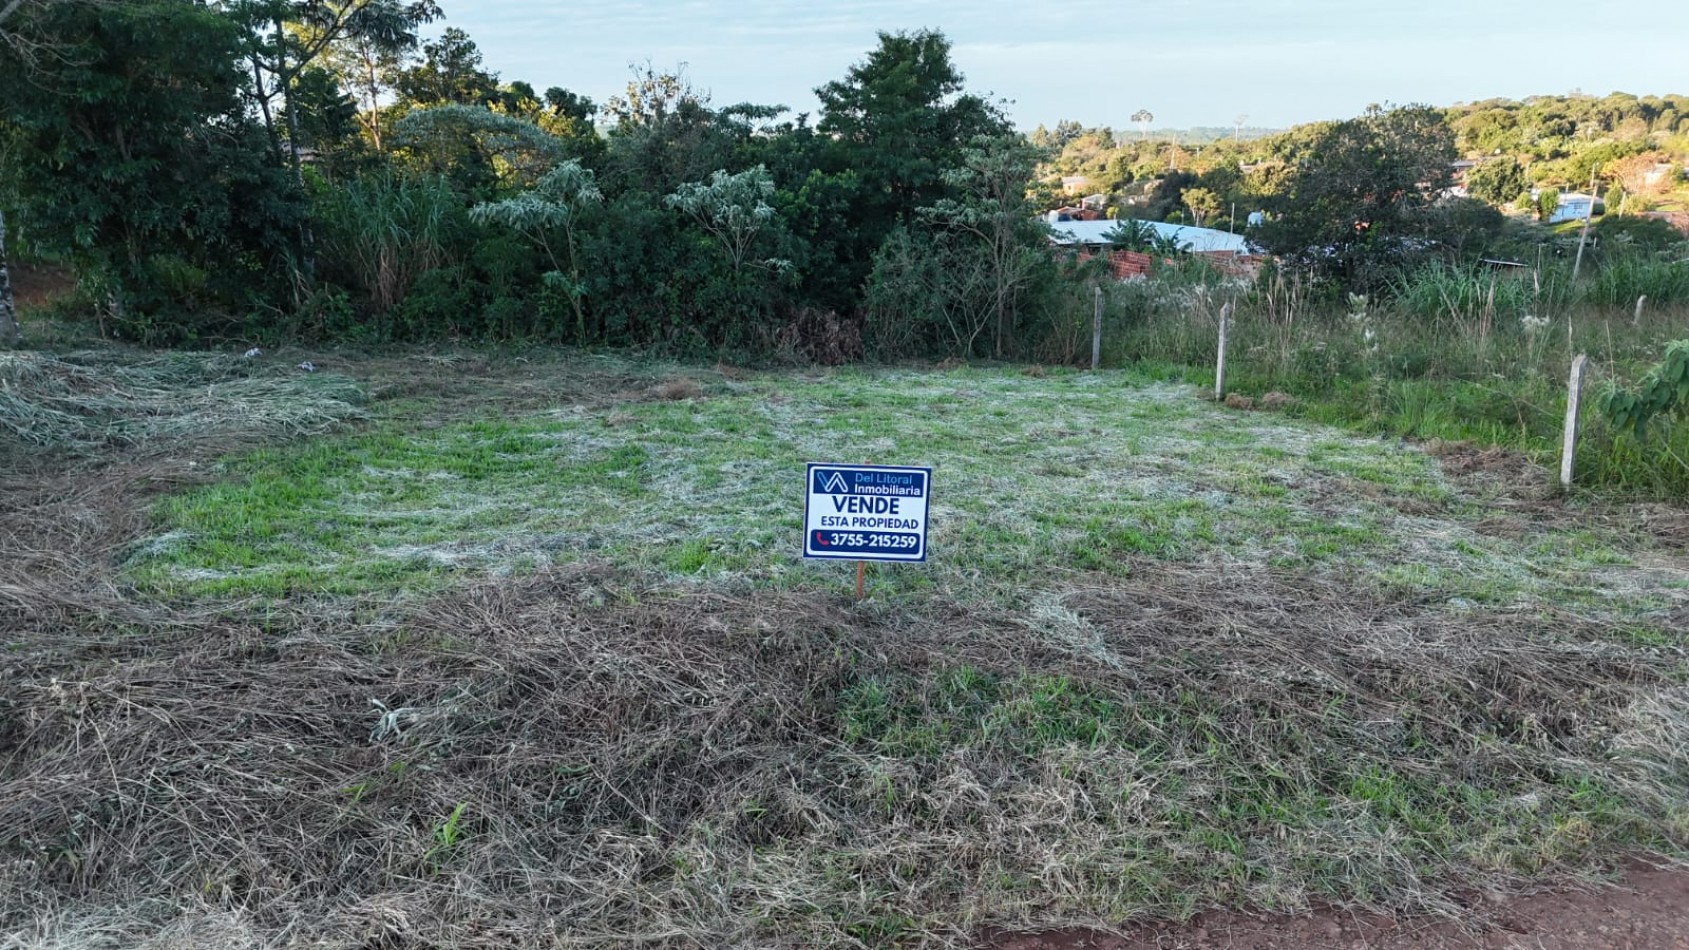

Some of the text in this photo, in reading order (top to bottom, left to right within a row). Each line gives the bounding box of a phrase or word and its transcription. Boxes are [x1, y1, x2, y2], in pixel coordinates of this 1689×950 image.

[855, 472, 912, 484] Del Litoral
[854, 484, 921, 496] Inmobiliaria
[832, 495, 900, 515] VENDE
[821, 516, 919, 529] ESTA PROPIEDAD
[830, 533, 917, 548] 3755-215259
